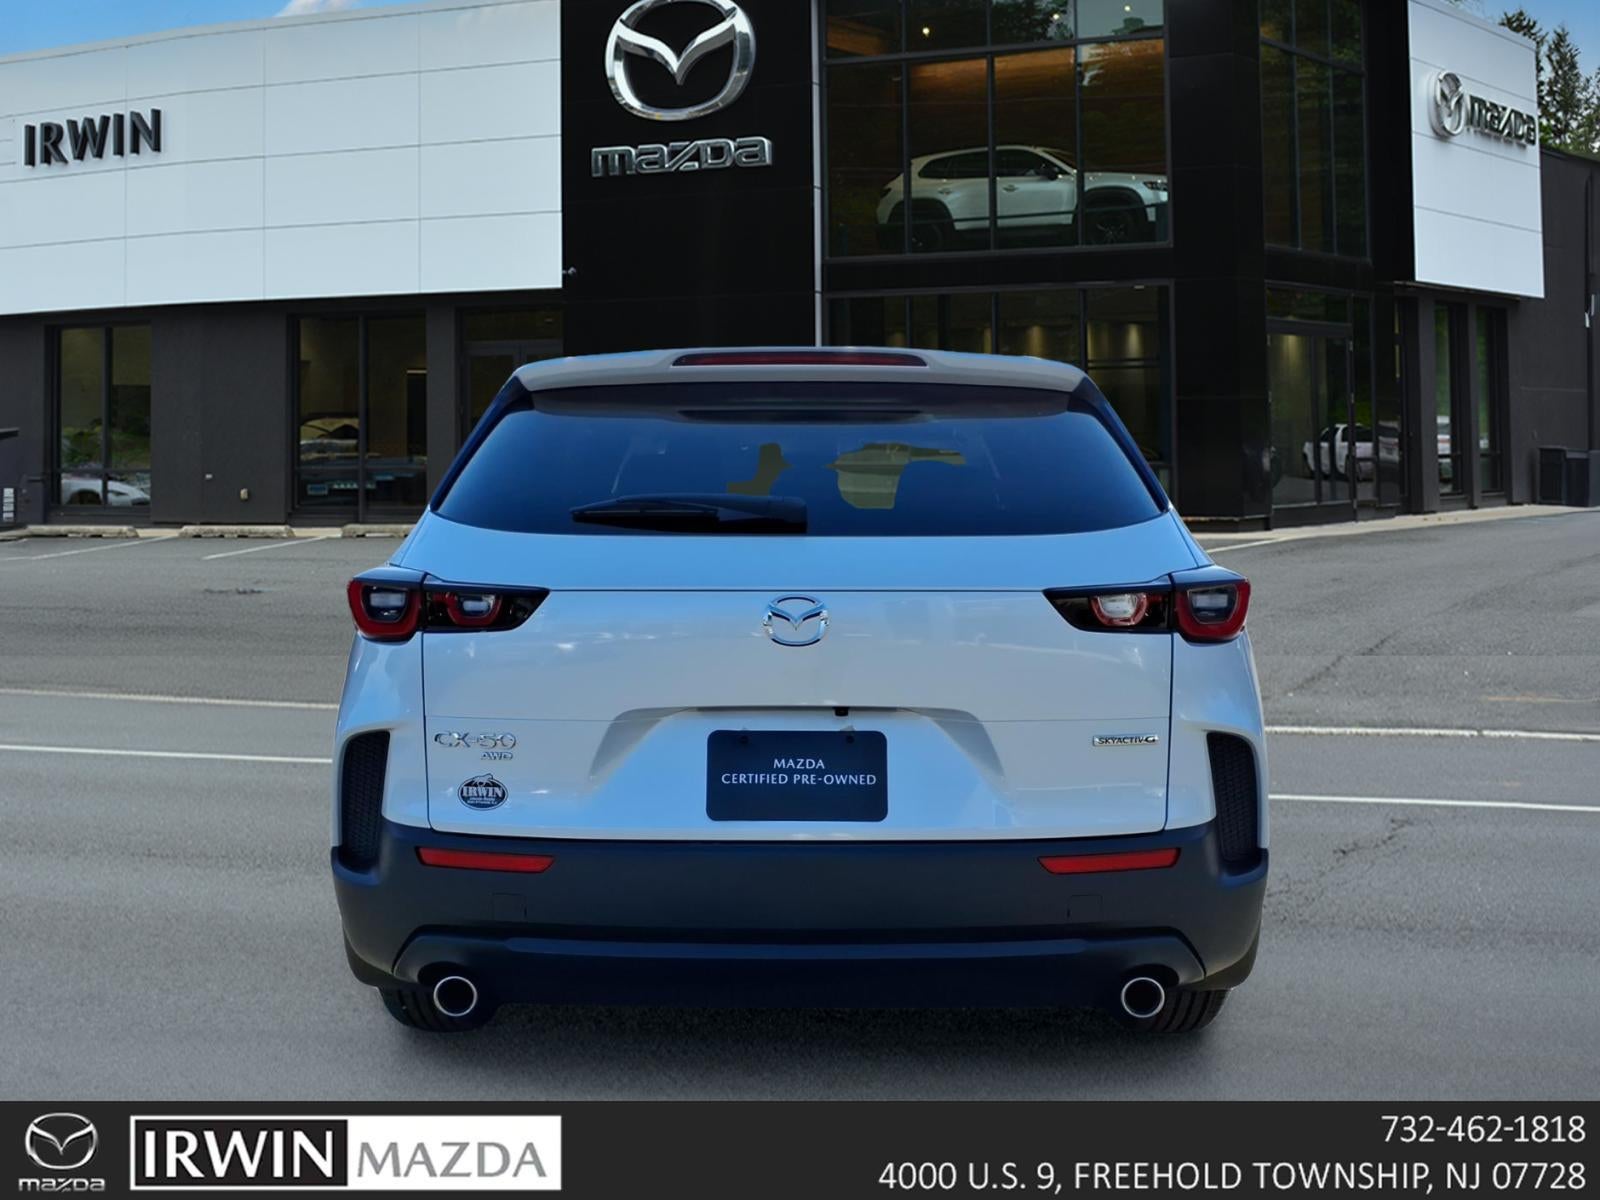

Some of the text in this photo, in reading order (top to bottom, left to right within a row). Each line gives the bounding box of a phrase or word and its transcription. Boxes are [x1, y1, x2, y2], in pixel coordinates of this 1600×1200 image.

[24, 108, 162, 167] IRWIN
[434, 732, 517, 750] CX-50
[480, 751, 514, 761] AWD
[773, 758, 825, 769] MAZDA
[721, 773, 877, 785] CERTIFIED PRE-OWNED
[462, 786, 503, 798] IRWIN
